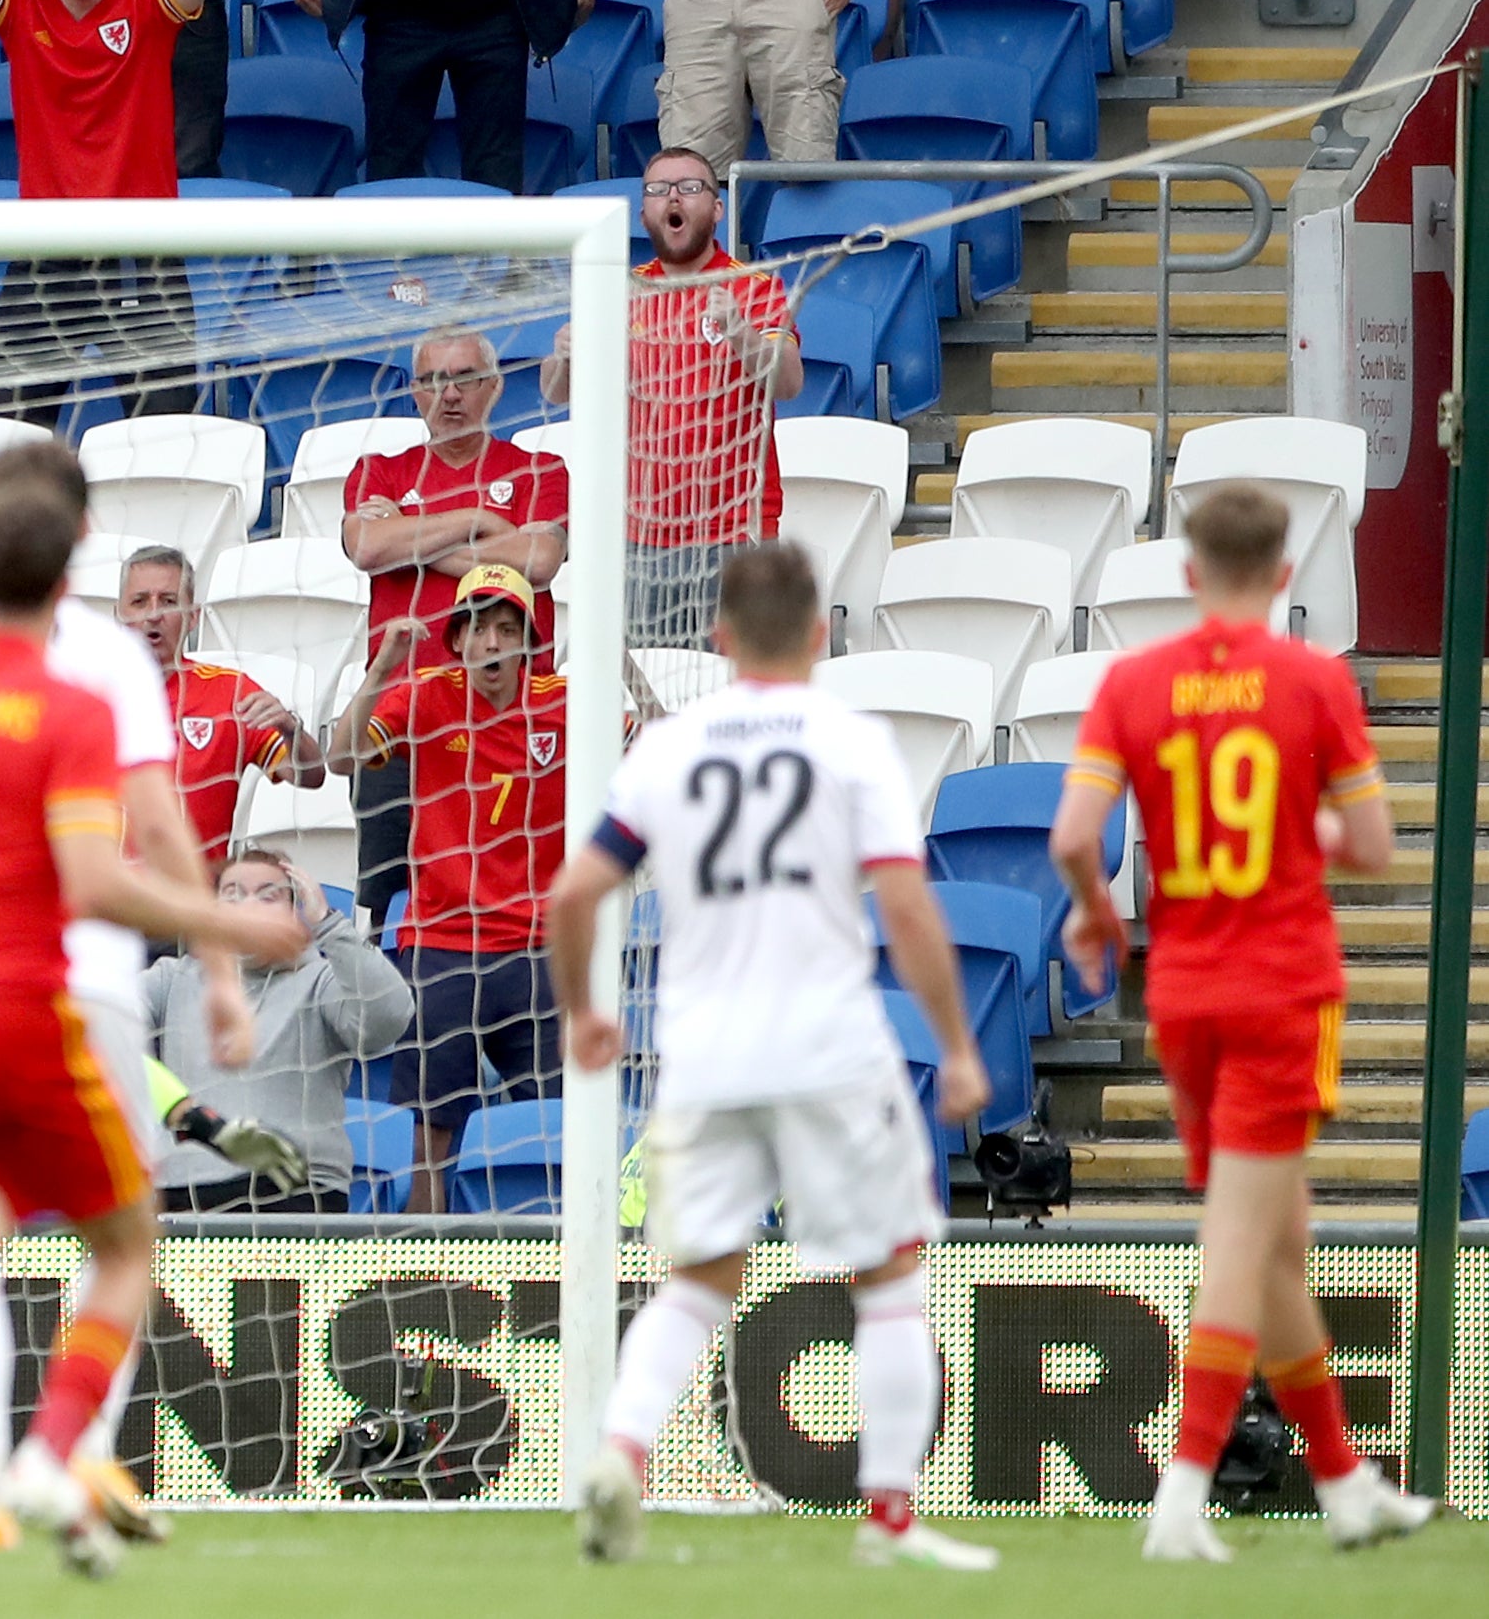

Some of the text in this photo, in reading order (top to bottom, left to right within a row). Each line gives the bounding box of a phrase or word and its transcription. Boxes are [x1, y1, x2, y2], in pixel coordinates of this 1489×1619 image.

[1360, 316, 1399, 350] University
[1360, 354, 1407, 380] South Wales
[489, 772, 514, 825] 7
[687, 748, 814, 898] 22
[1155, 724, 1281, 900] 19
